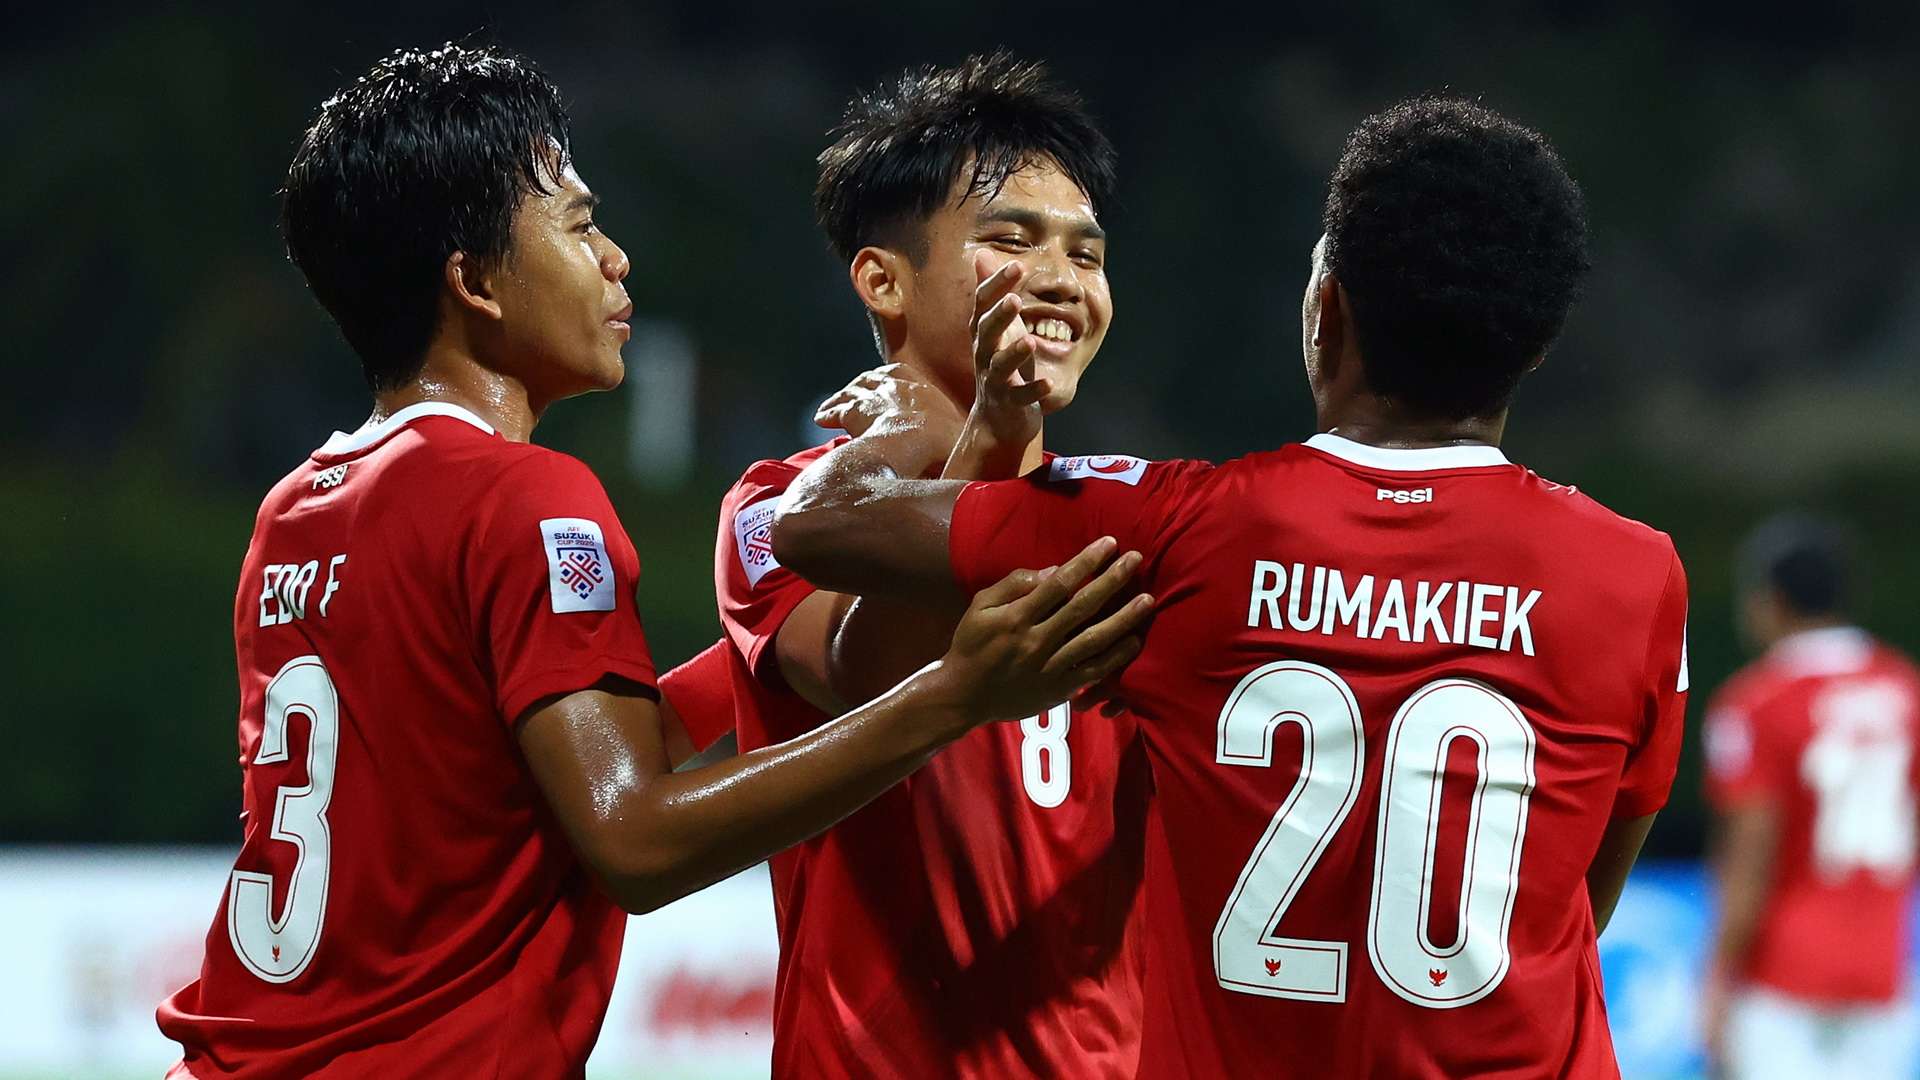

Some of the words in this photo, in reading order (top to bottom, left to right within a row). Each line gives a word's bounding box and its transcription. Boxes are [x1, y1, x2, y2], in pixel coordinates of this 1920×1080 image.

[313, 464, 349, 490] PSSI
[1376, 487, 1433, 504] PSSI
[554, 532, 595, 541] SUZUKI
[259, 559, 319, 628] EDO
[319, 553, 347, 617] F
[1247, 559, 1543, 657] RUMAKIEK
[1019, 700, 1071, 809] 8
[227, 655, 339, 984] 3
[1212, 660, 1537, 1009] 20
